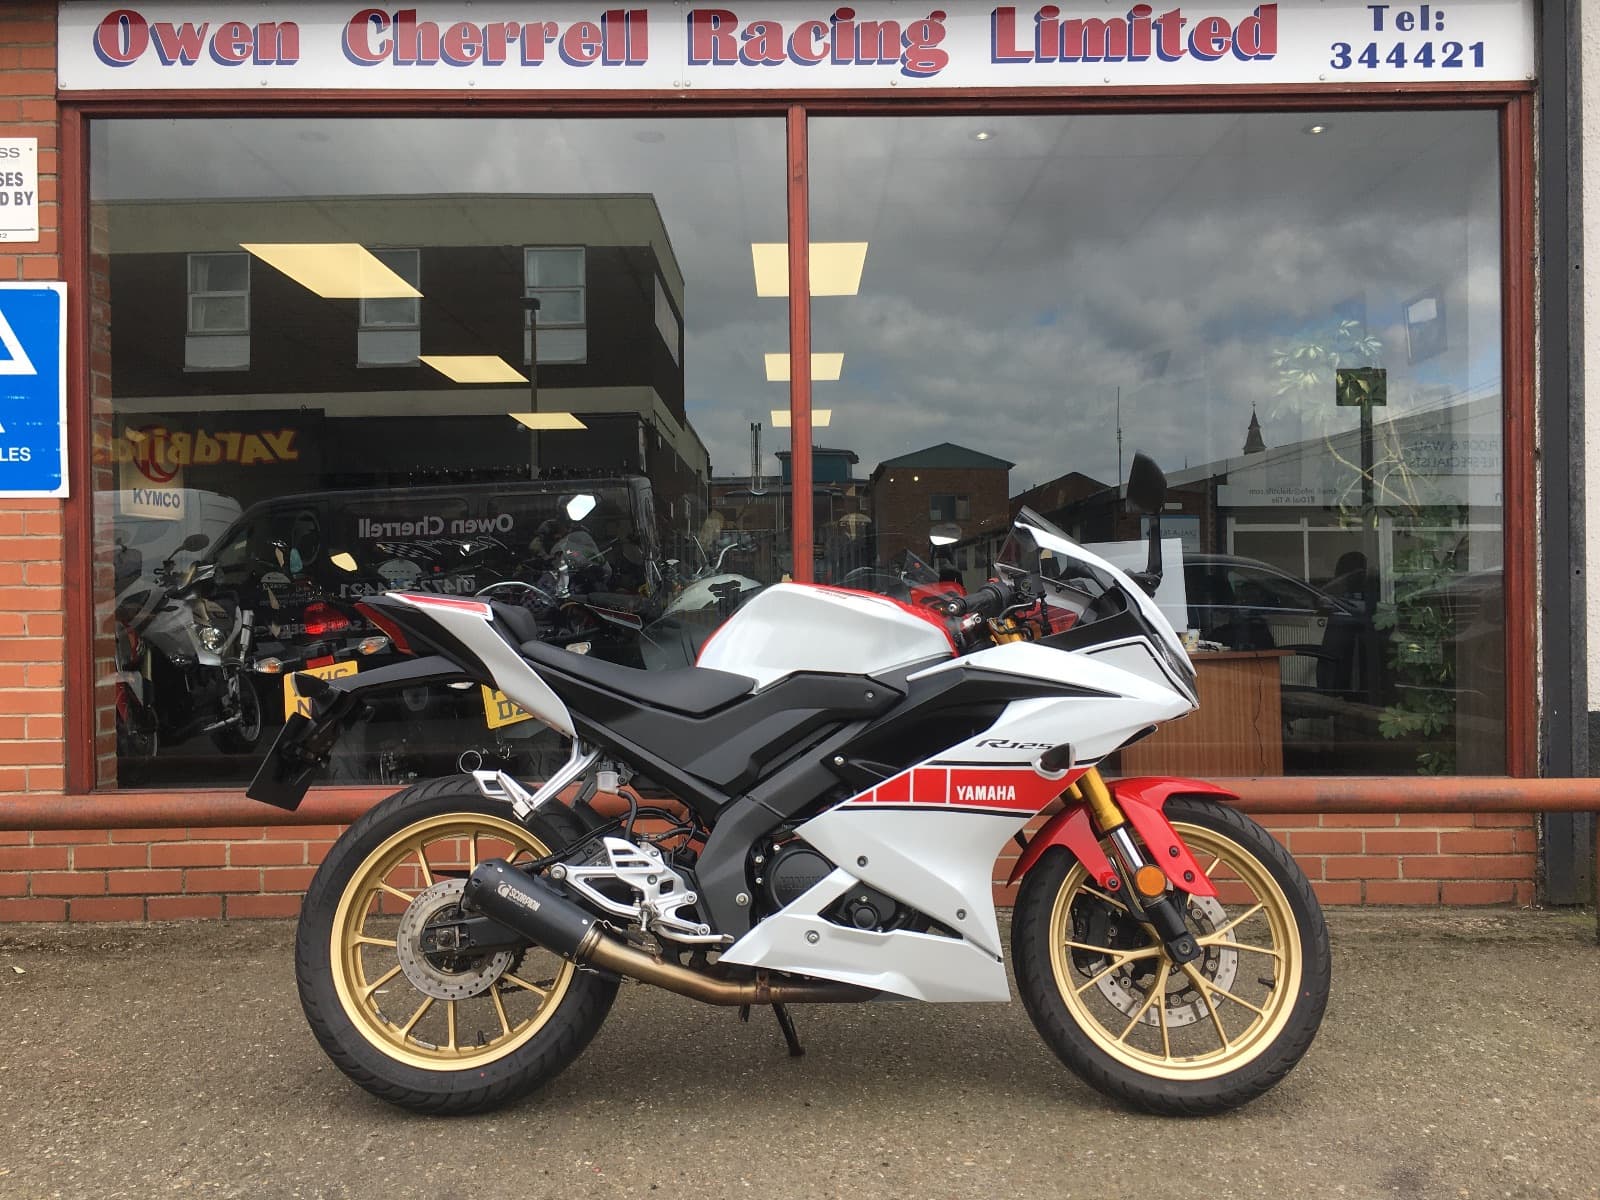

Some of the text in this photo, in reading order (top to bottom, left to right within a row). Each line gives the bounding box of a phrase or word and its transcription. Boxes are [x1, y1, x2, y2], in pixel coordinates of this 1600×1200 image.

[1367, 5, 1446, 33] Tel:
[93, 5, 1279, 77] Owen Cherrell Racing Limited
[1330, 42, 1486, 70] 344421
[14, 191, 33, 206] BY
[132, 487, 180, 510] KYMCO
[956, 785, 1016, 800] YAMAHA
[508, 888, 541, 912] SCORPION
